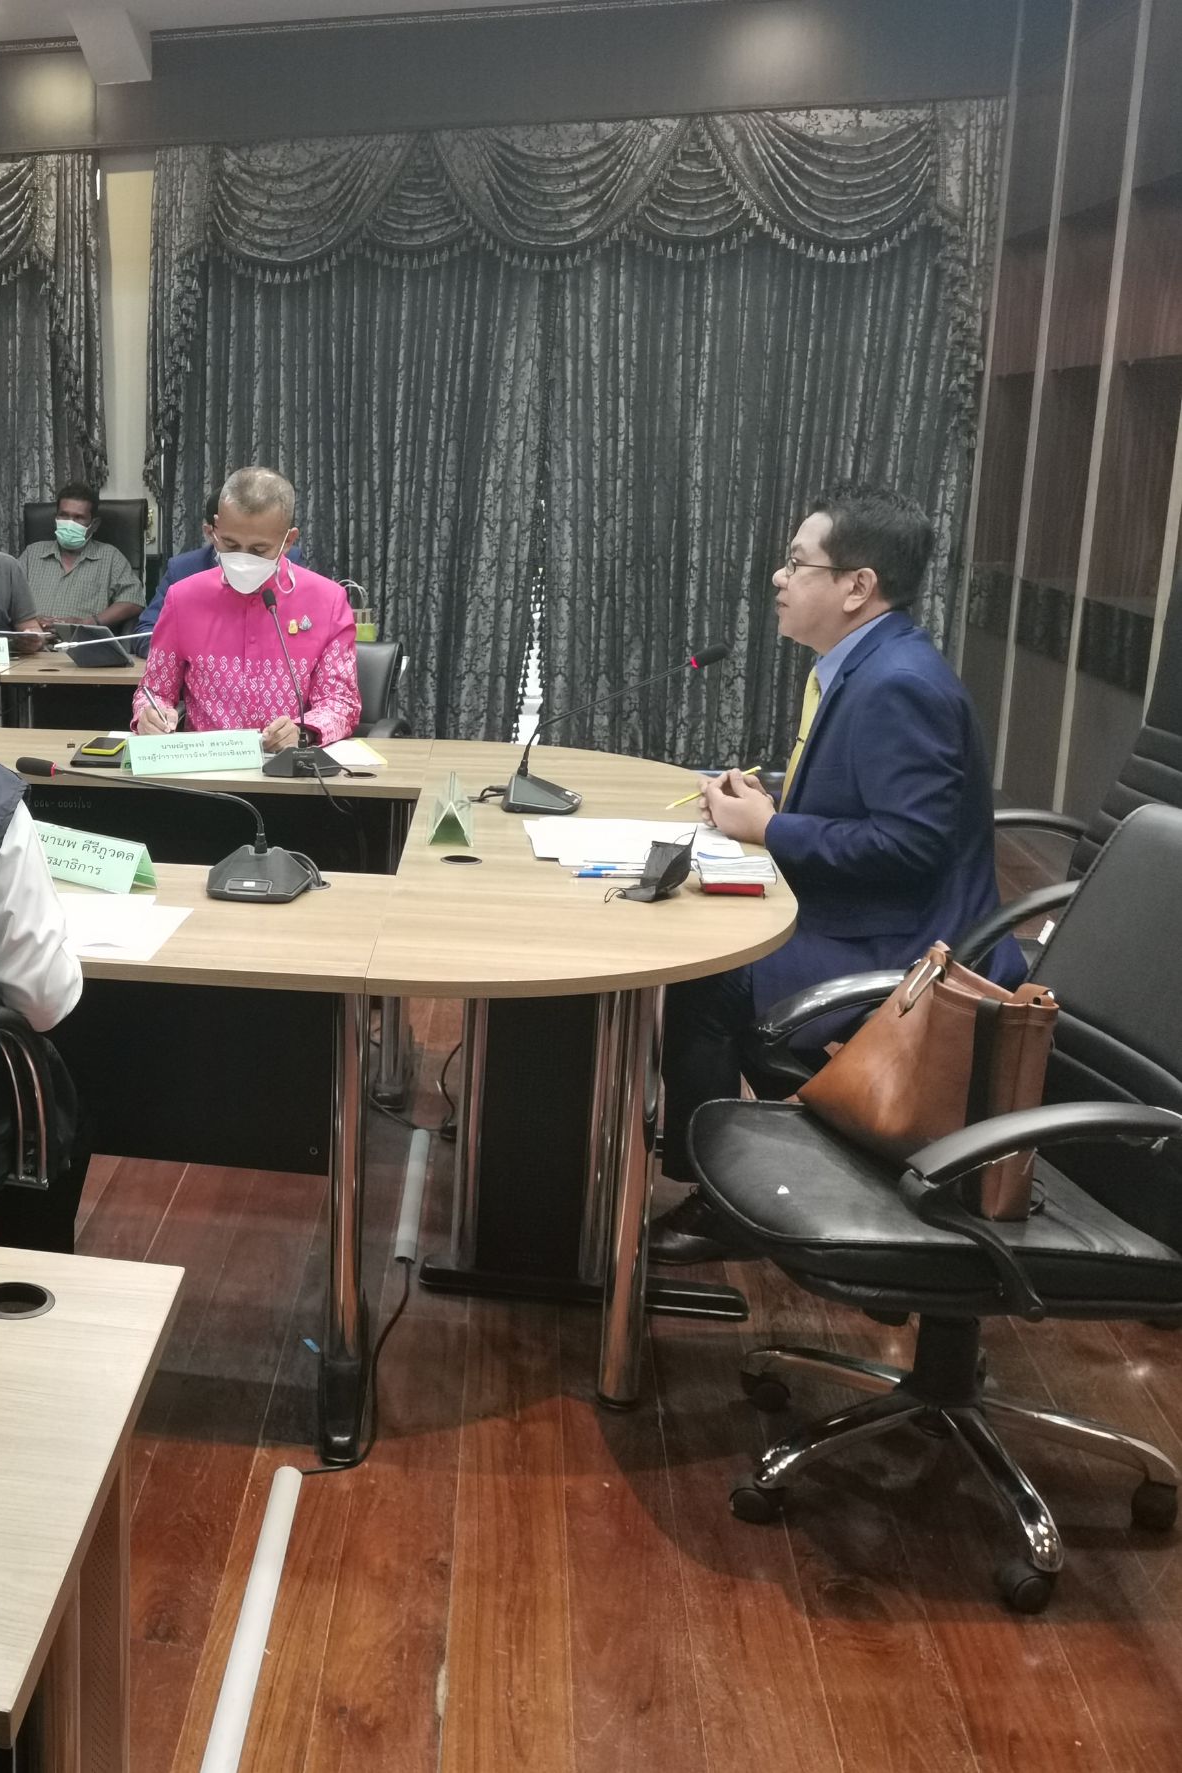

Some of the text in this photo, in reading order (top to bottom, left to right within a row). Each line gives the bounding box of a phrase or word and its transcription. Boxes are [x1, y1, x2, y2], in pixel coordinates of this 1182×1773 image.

[38, 832, 77, 849] มานพ
[46, 855, 103, 876] รมาธิการ
